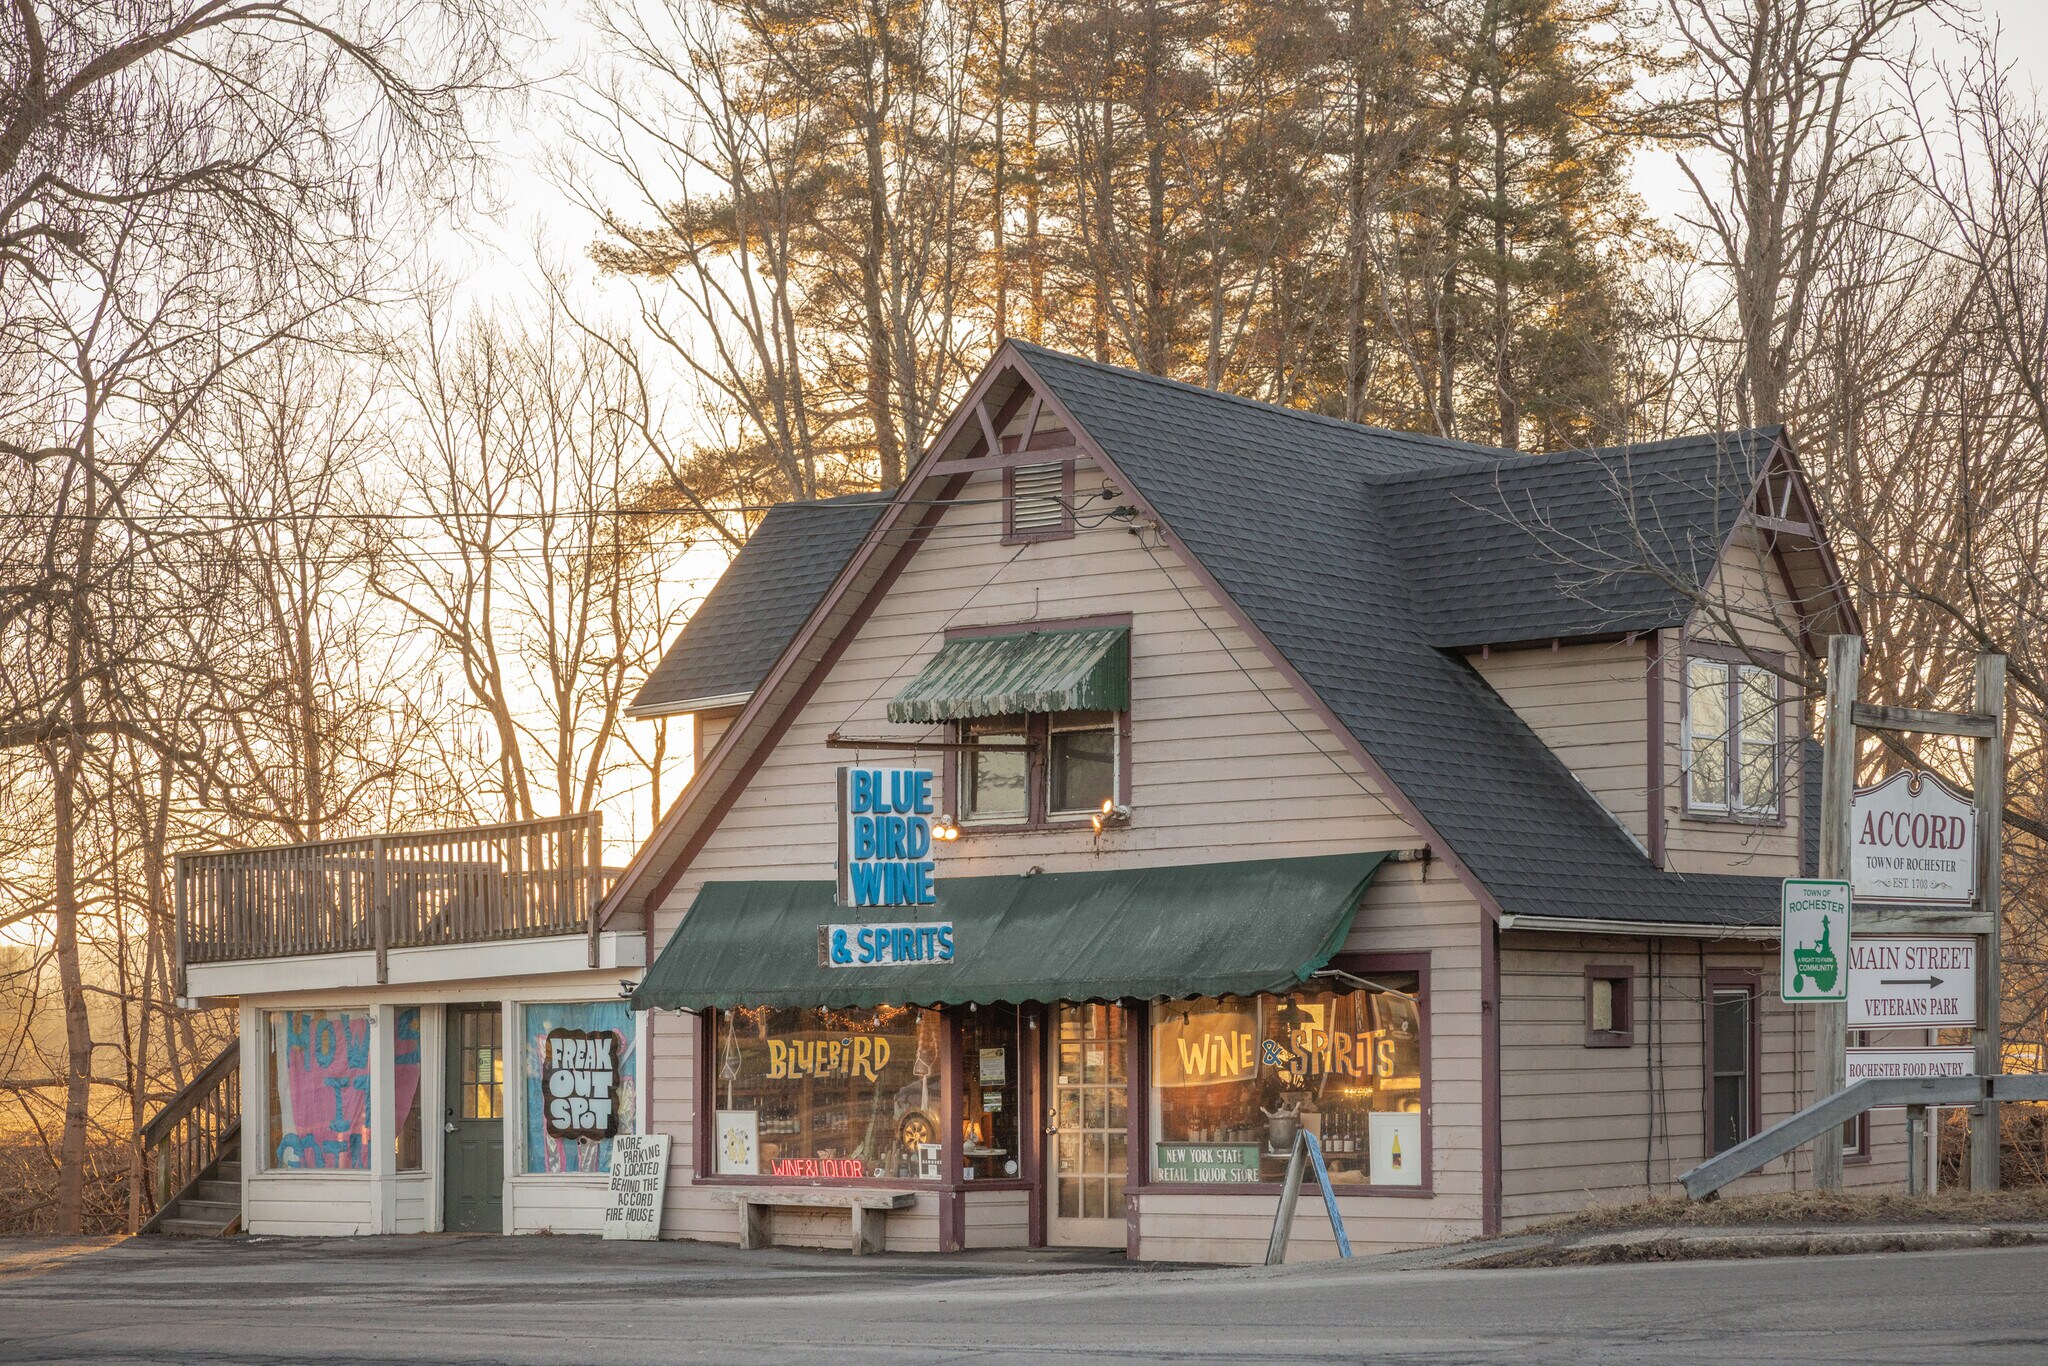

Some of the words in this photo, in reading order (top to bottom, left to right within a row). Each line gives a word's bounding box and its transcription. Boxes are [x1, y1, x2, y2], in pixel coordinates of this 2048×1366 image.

[851, 770, 934, 814] BLUE
[854, 816, 930, 859] BIRD
[1859, 809, 1967, 850] ACCORD
[1866, 856, 1892, 870] TOWN
[1893, 857, 1905, 871] OF
[1906, 858, 1957, 873] ROCHESTER
[850, 862, 937, 905] WINE
[1892, 877, 1909, 888] EST.
[1911, 877, 1929, 889] 1703
[1803, 889, 1821, 897] TOWN
[1822, 889, 1831, 897] OF
[1789, 899, 1845, 914] ROCHESTER
[831, 928, 853, 964] &
[858, 925, 955, 963] SPIRITS
[1849, 946, 1901, 970] MAIN
[1905, 946, 1973, 970] STREET
[1864, 998, 1927, 1016] VETERANS
[1930, 997, 1958, 1015] PARK
[549, 1038, 612, 1070] FREAK
[766, 1036, 891, 1083] BLUEBIRD
[1177, 1030, 1255, 1077] WINE
[1262, 1039, 1283, 1067] &
[1290, 1029, 1396, 1078] SPIRITS
[1849, 1063, 1901, 1077] ROCHESTER
[1903, 1063, 1927, 1077] FOOD
[1929, 1062, 1964, 1077] PANTRY
[549, 1070, 613, 1098] OUT
[549, 1098, 612, 1130] SPOT
[617, 1136, 643, 1152] MORE
[623, 1144, 660, 1164] PARKING
[1166, 1149, 1186, 1163] NEW
[1190, 1149, 1214, 1163] YORK
[1216, 1149, 1244, 1164] STATE
[612, 1164, 621, 1177] IS
[624, 1162, 658, 1177] LOCATED
[1158, 1168, 1189, 1182] RETAIL
[1194, 1168, 1227, 1182] LIQUOR
[1231, 1168, 1260, 1182] STORE
[611, 1177, 641, 1193] BEHIND
[643, 1178, 658, 1191] THE
[617, 1192, 653, 1207] ACCORD
[605, 1207, 623, 1222] FIRE
[625, 1208, 654, 1222] HOUSE
